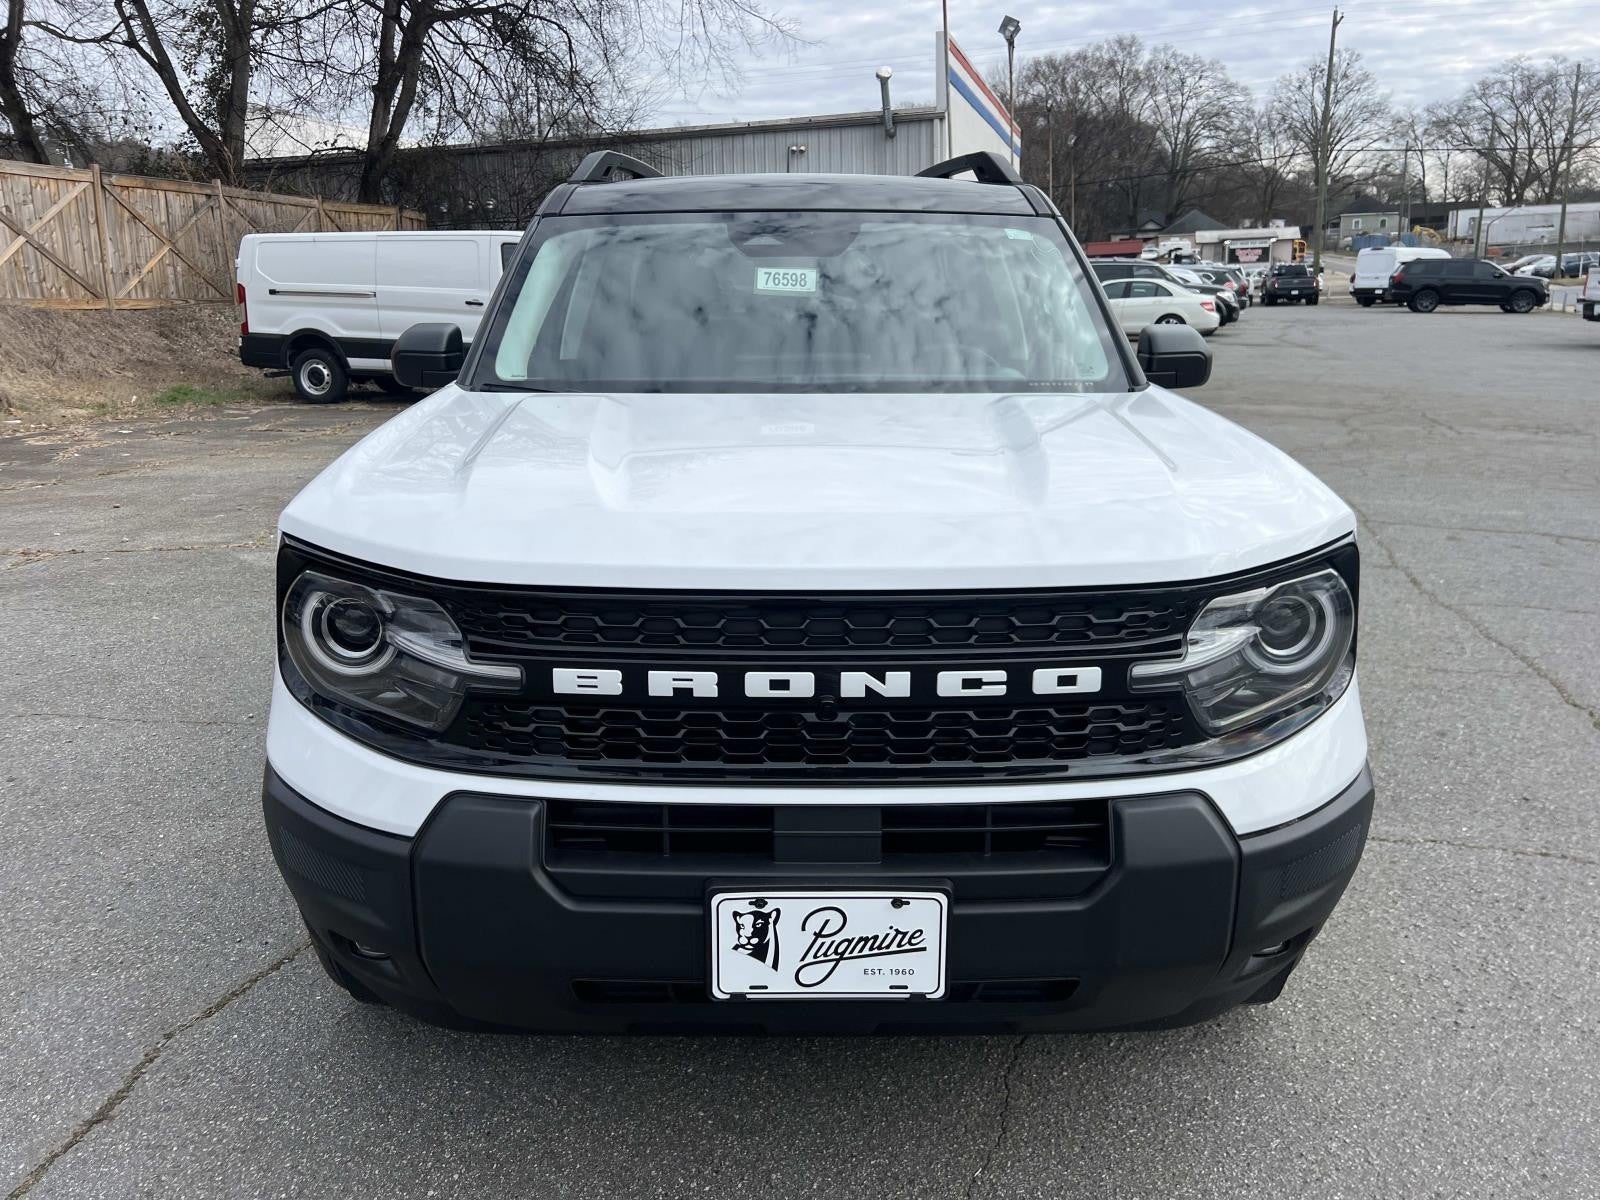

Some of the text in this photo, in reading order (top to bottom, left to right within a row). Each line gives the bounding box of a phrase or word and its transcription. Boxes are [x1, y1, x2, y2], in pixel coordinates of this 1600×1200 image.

[763, 271, 808, 288] 76598
[552, 666, 1103, 699] BRONCO
[795, 906, 927, 987] Pugmire
[863, 968, 915, 976] EST. 1960
